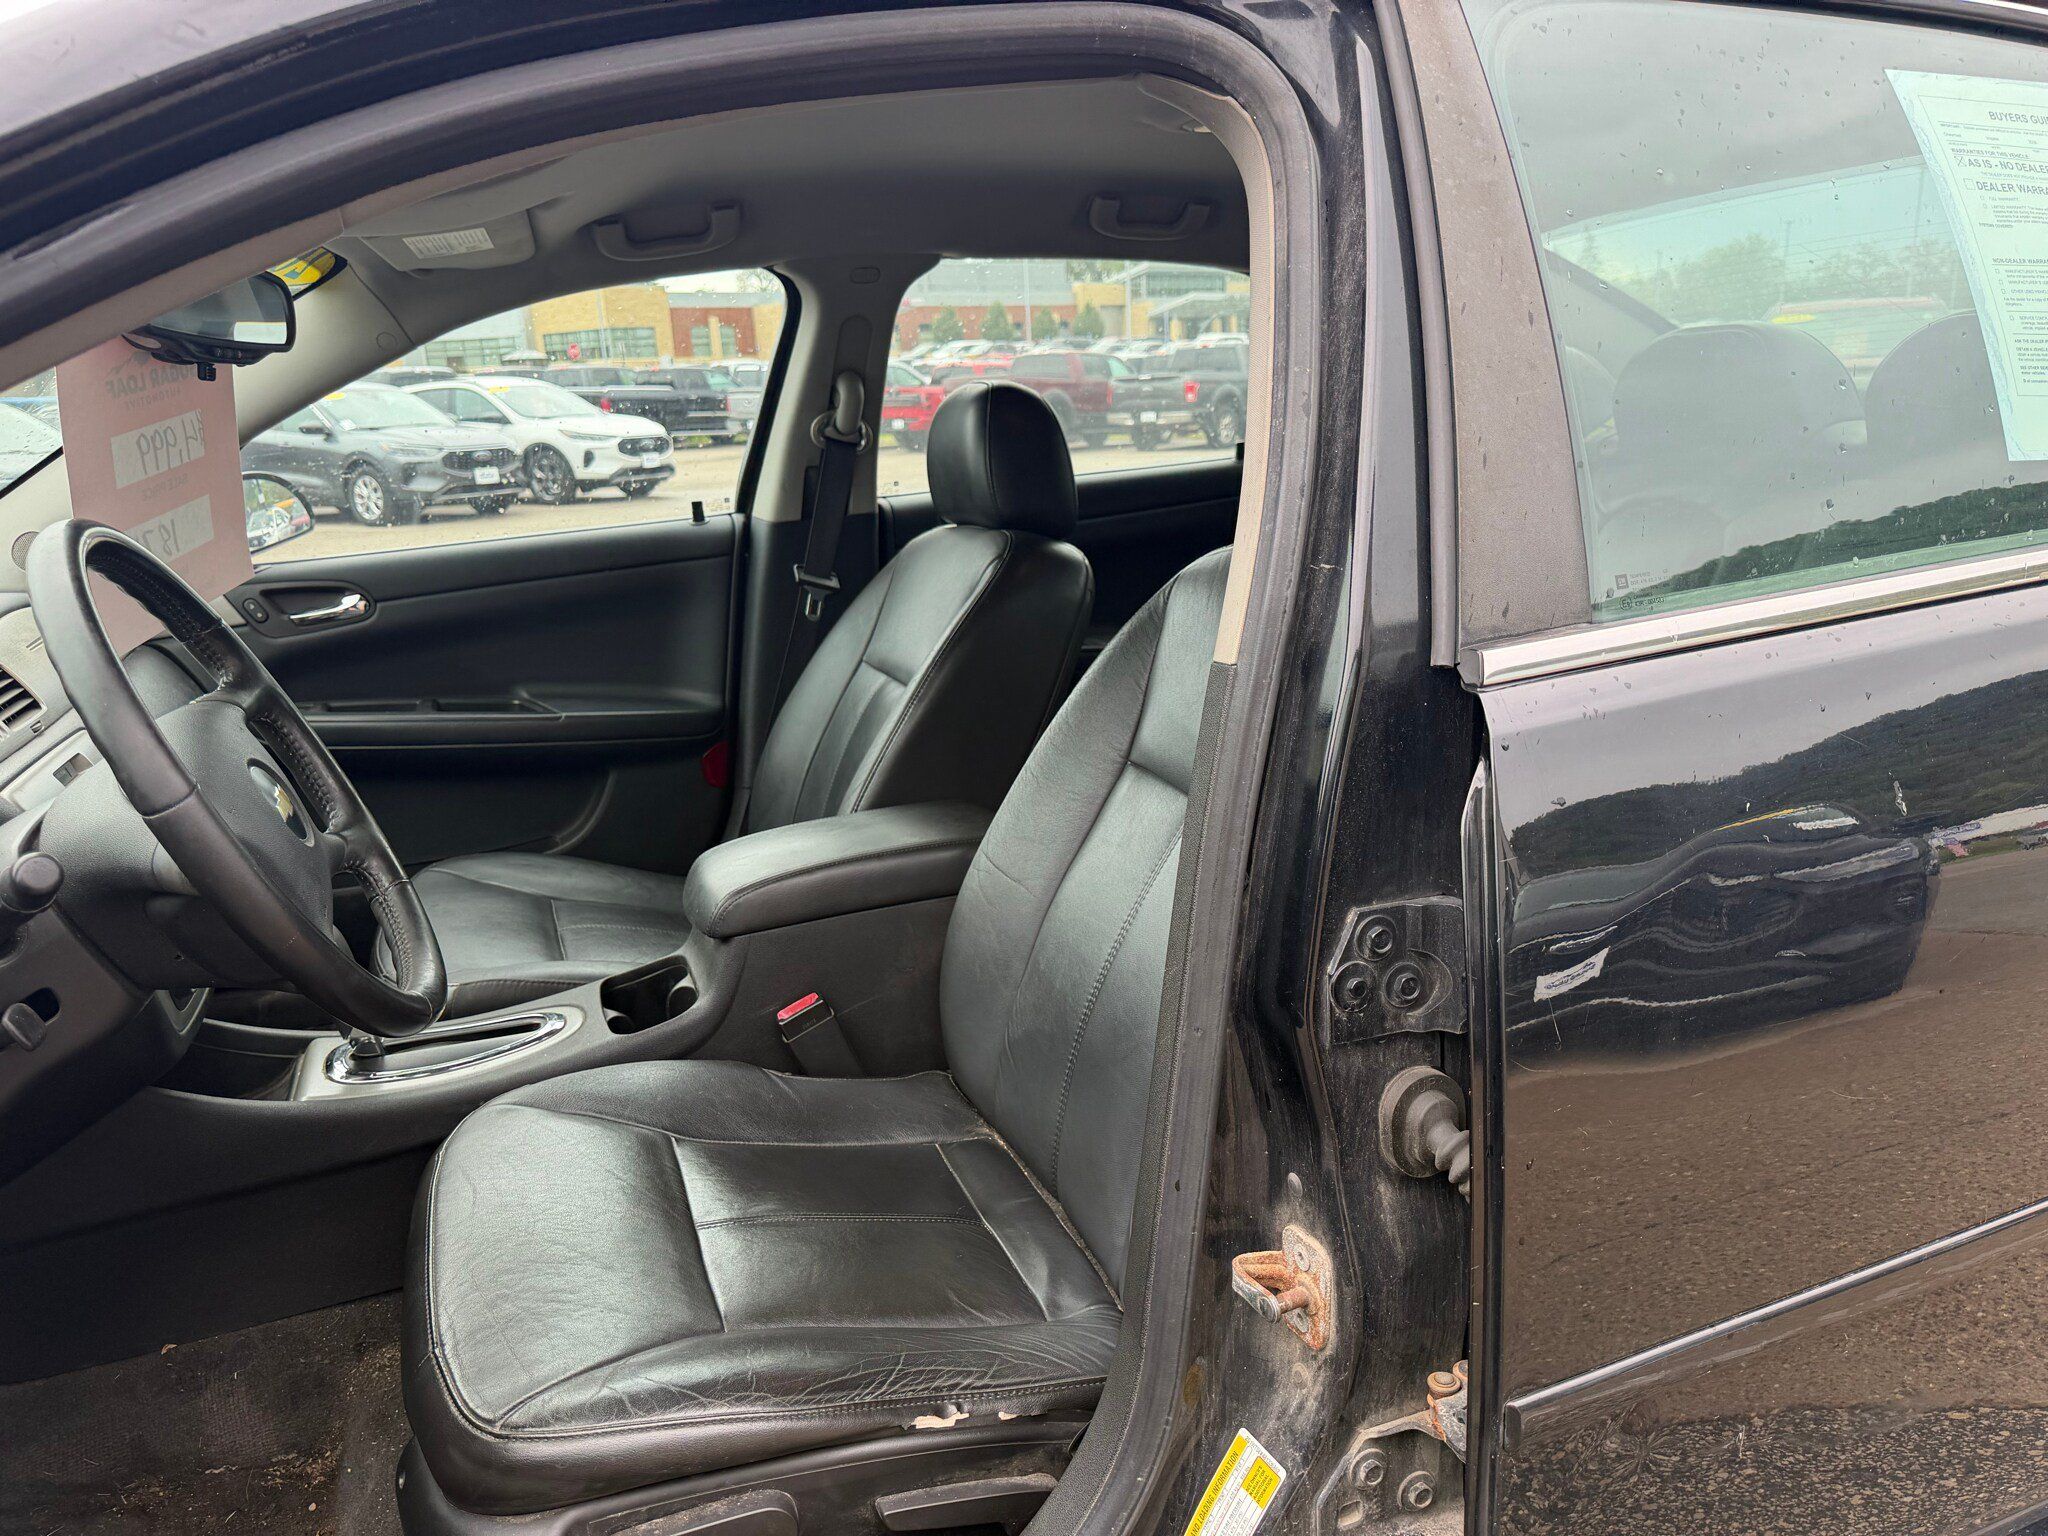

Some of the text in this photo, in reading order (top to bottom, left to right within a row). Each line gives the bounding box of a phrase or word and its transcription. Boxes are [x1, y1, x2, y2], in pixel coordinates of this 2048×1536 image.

[1988, 111, 2029, 123] BUYERS
[1967, 158, 1982, 168] AS
[1983, 159, 1993, 169] IS
[1999, 160, 2014, 170] NO
[1976, 181, 2015, 192] DEALER
[1197, 1495, 1214, 1525] LOADING
[1212, 1451, 1239, 1496] INFORMATION
